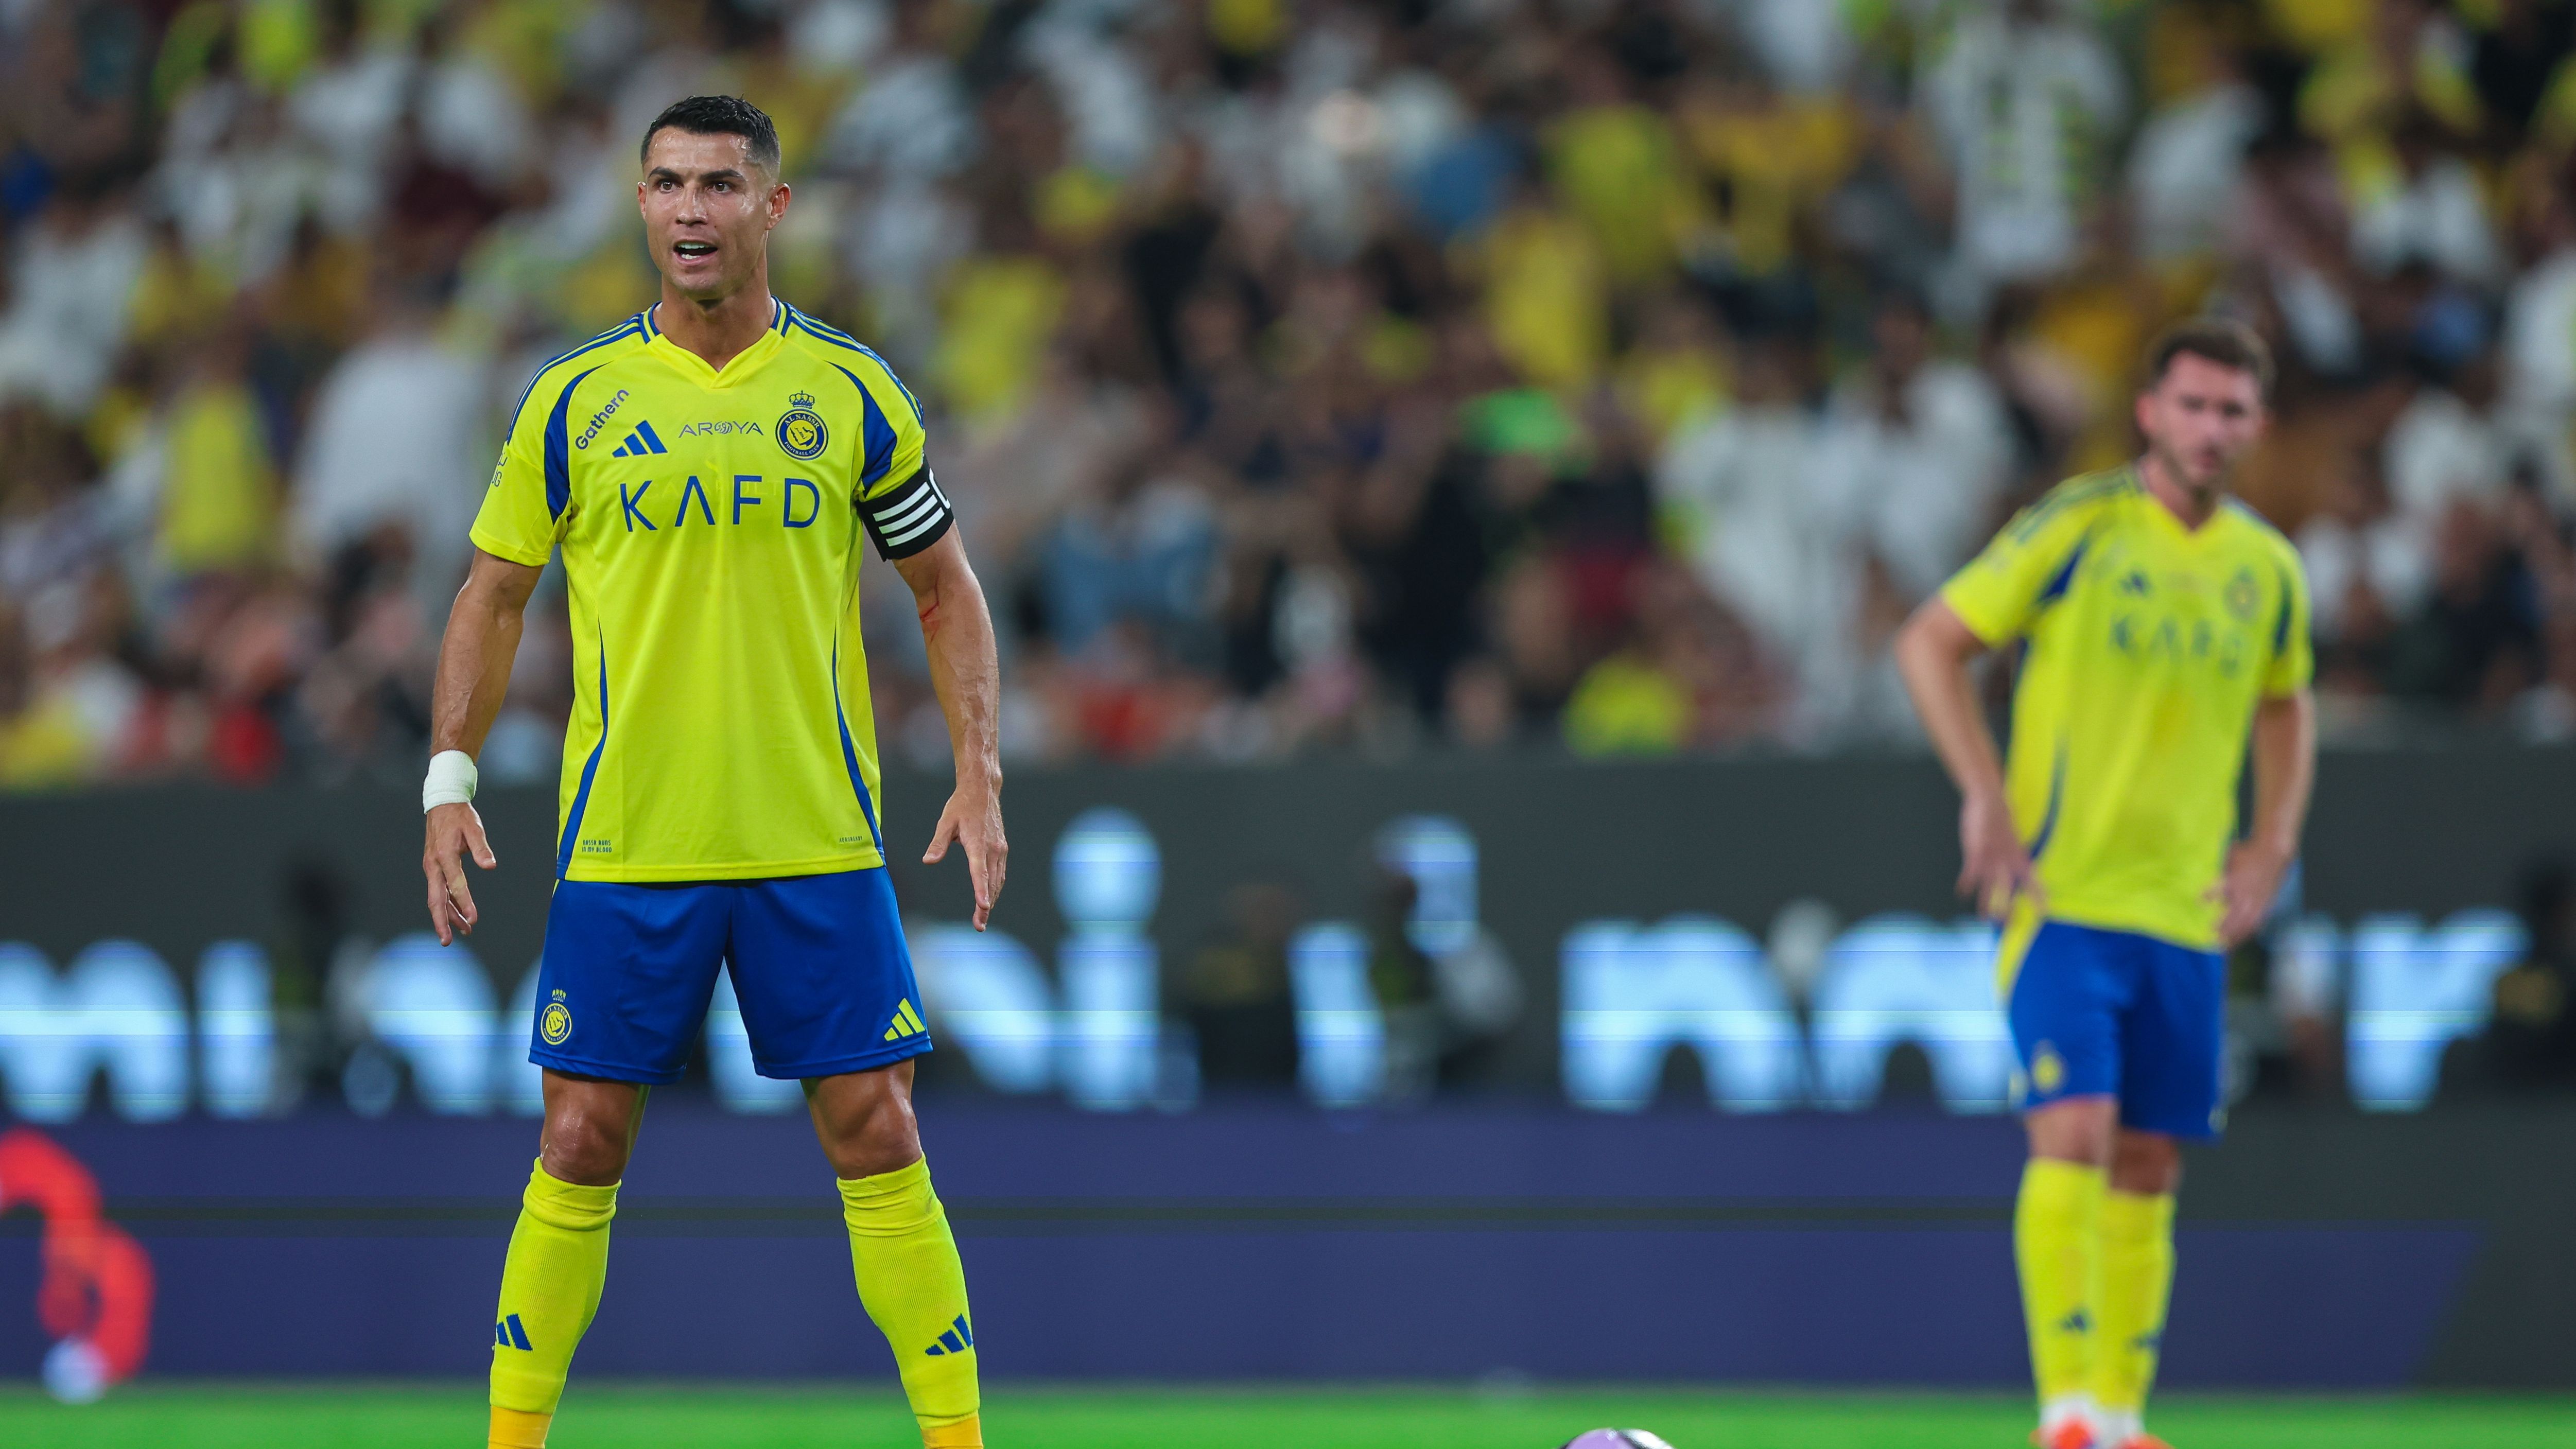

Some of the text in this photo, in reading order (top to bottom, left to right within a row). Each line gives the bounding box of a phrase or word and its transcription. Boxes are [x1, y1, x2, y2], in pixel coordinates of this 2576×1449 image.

[575, 389, 630, 450] Gathern
[678, 421, 764, 438] AROYA
[784, 441, 809, 456] FOOTBALL
[620, 475, 820, 532] KAFD
